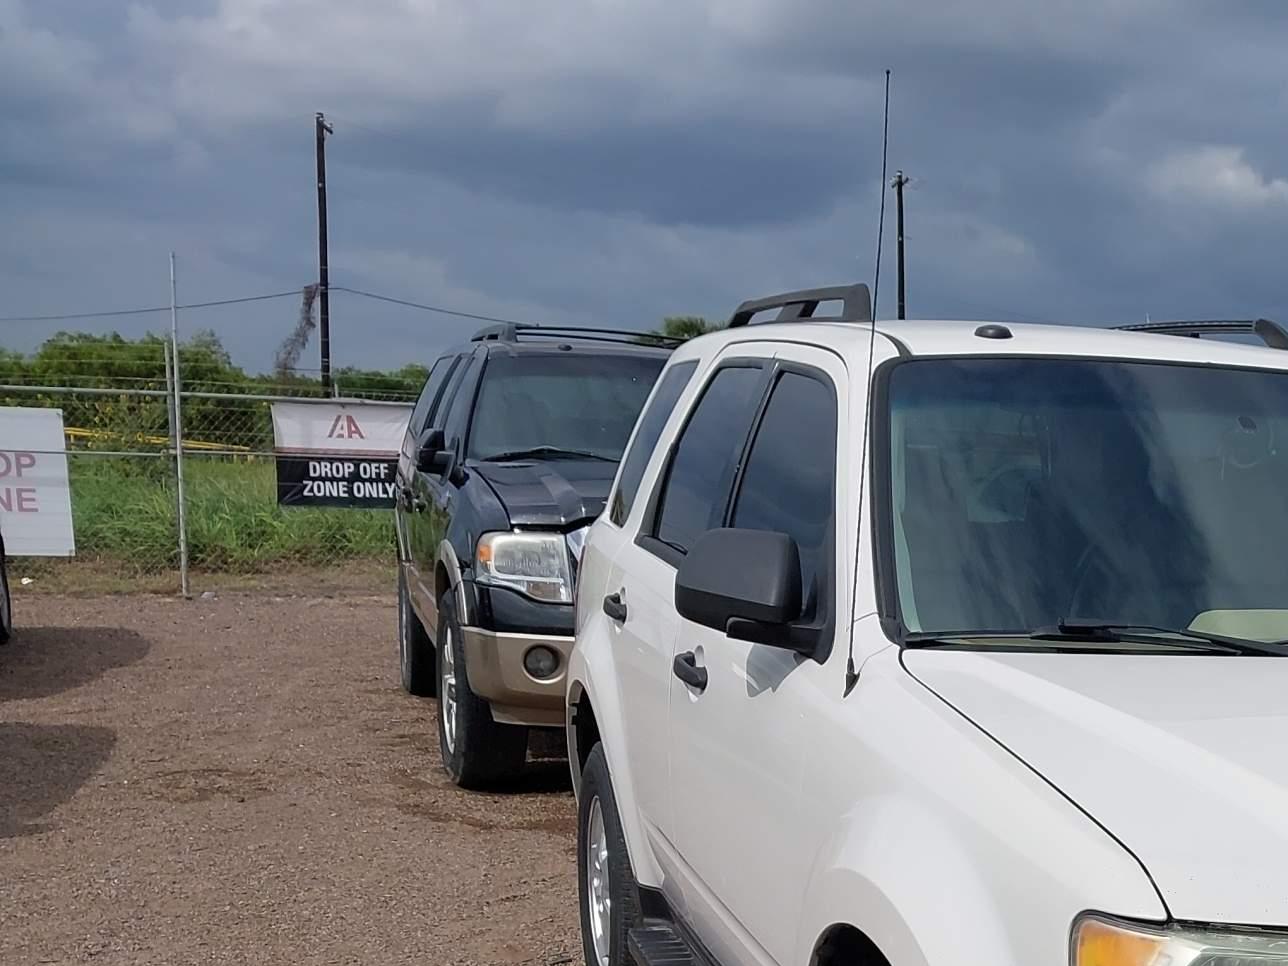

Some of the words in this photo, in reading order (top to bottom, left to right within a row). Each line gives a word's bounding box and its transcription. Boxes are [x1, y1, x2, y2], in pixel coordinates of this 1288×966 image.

[309, 461, 355, 478] DROP
[359, 463, 389, 479] OFF
[302, 480, 349, 498] ZONE
[353, 481, 396, 499] ONLY
